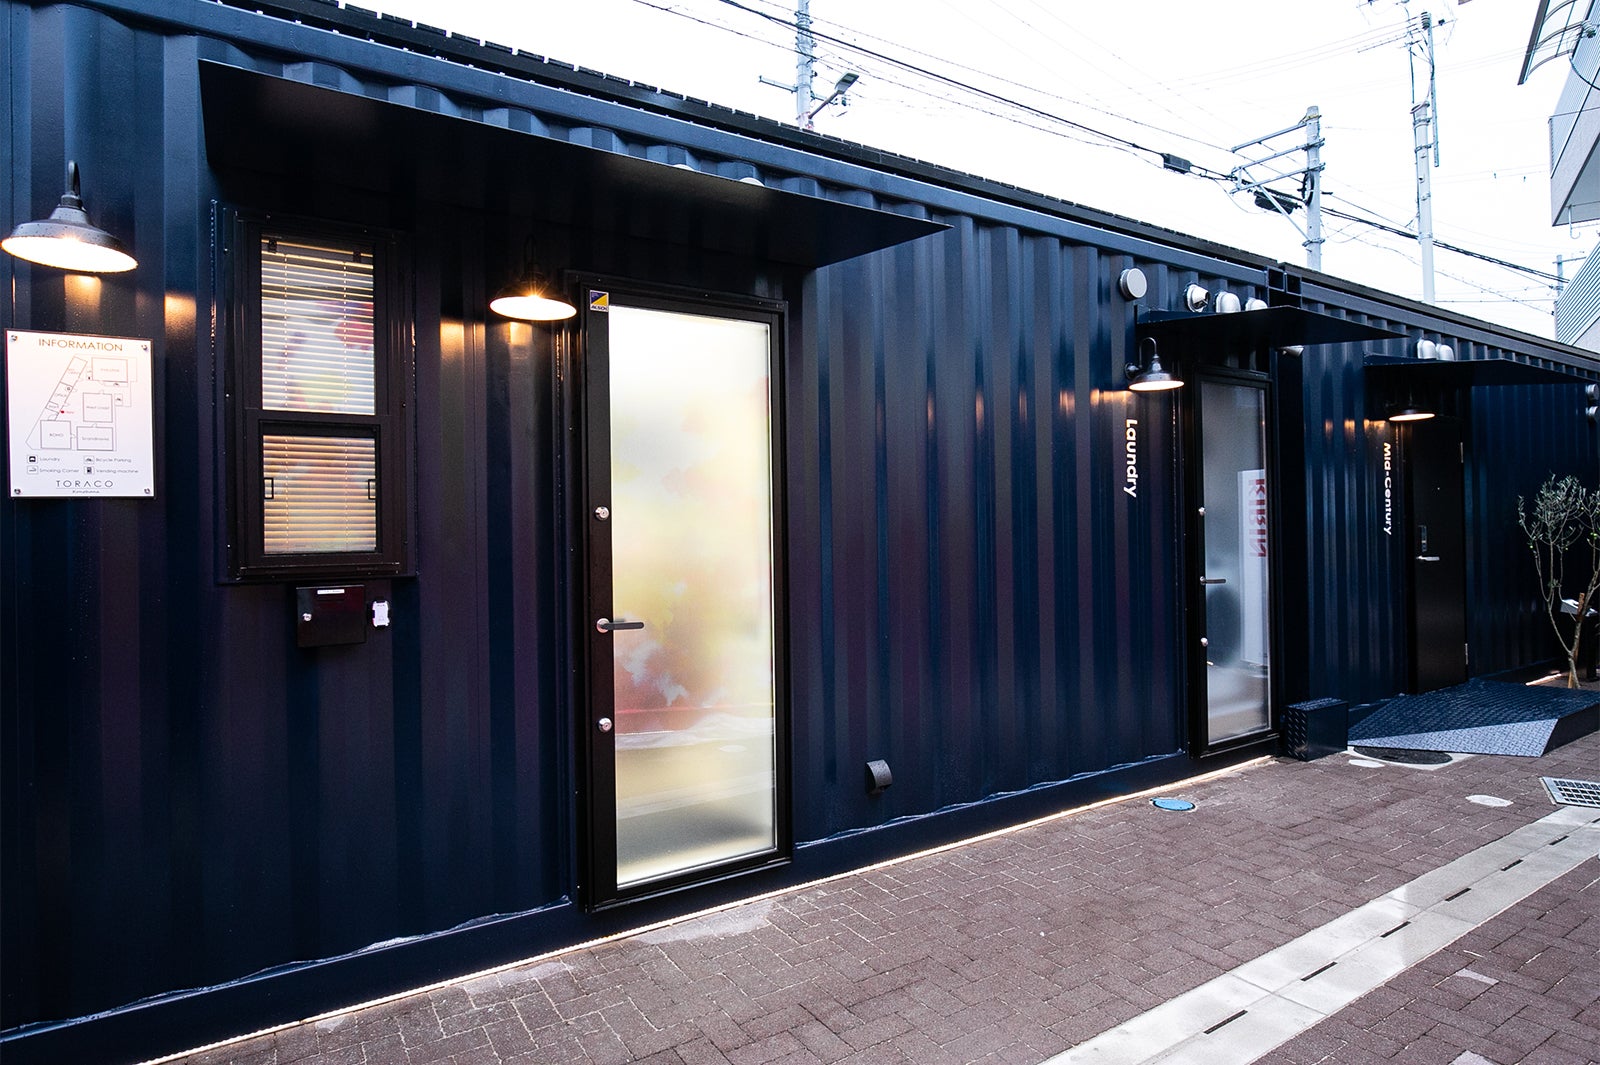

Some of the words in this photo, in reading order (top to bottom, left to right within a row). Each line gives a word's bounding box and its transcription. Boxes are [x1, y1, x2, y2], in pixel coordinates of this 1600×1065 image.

[38, 338, 123, 352] INFORMATION
[1123, 419, 1138, 498] Laundry
[55, 480, 114, 488] TORACO
[1383, 442, 1392, 536] Mid-Century
